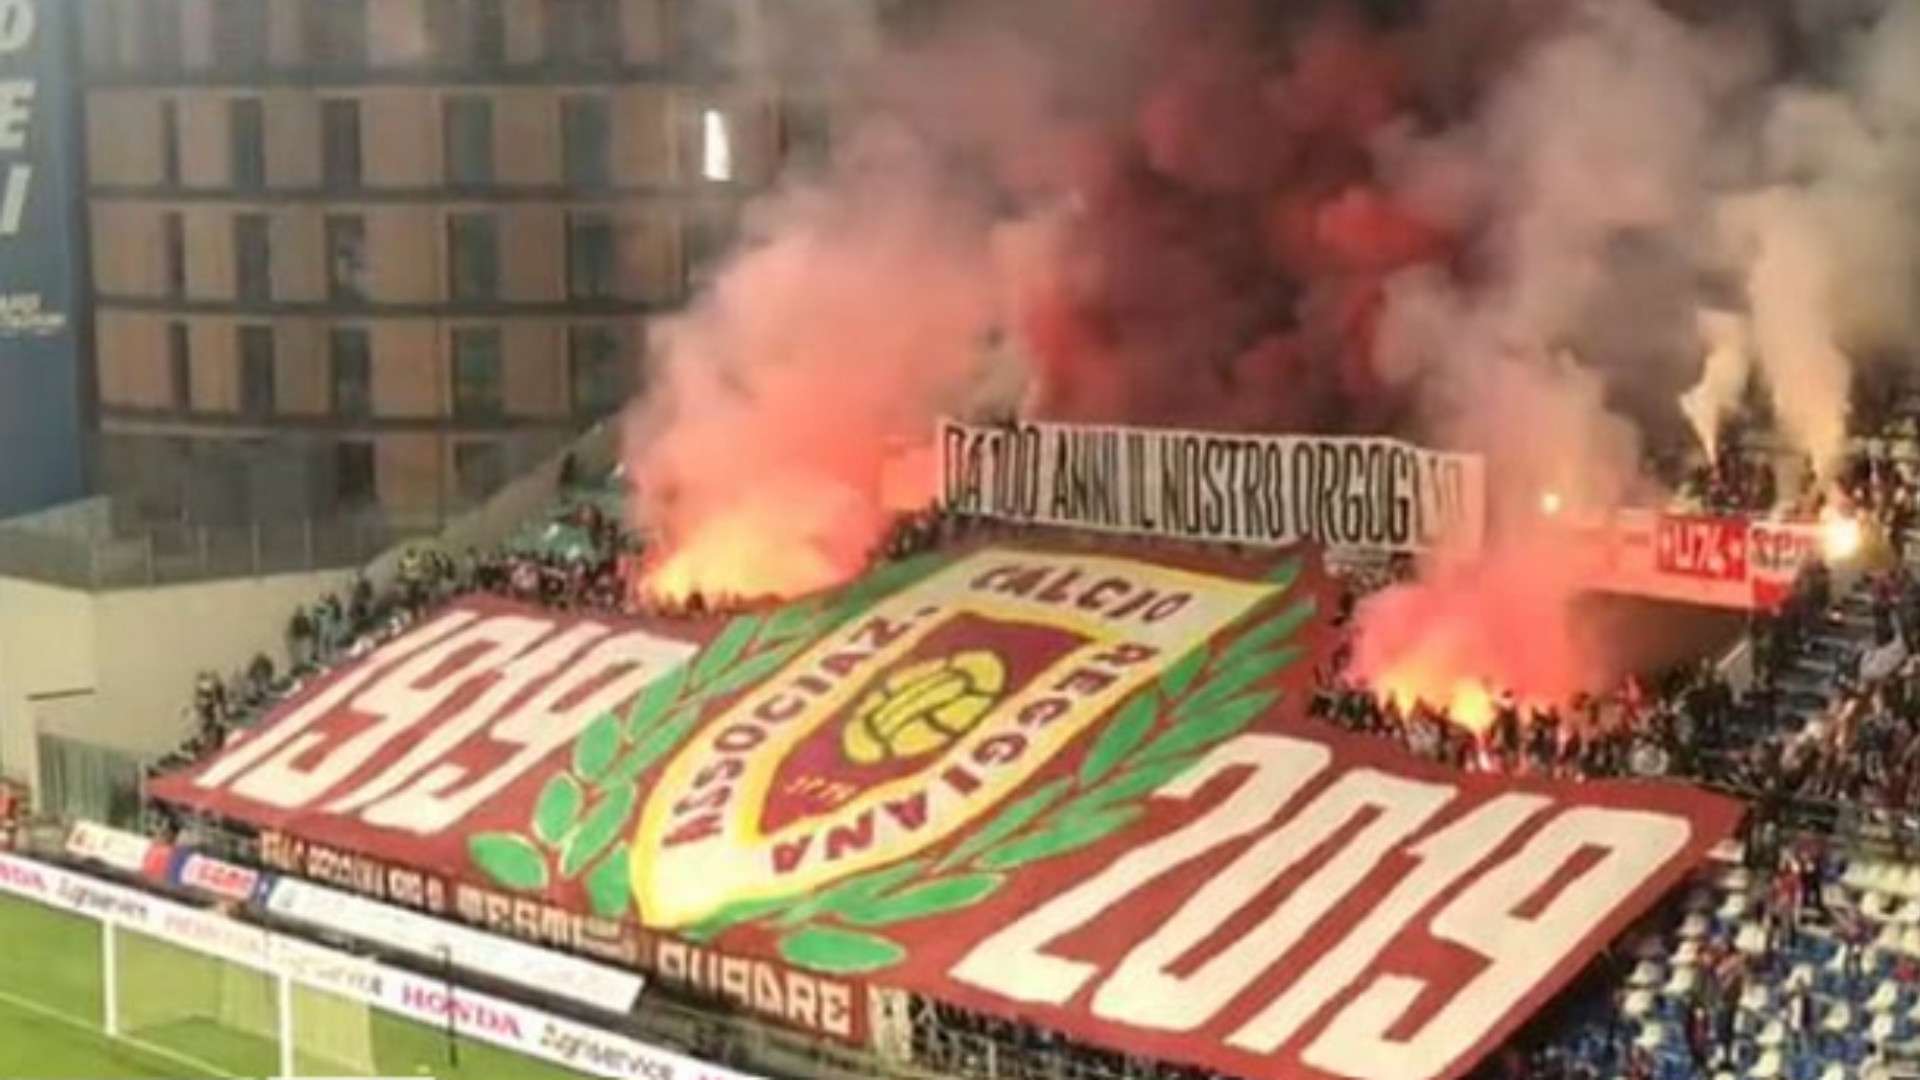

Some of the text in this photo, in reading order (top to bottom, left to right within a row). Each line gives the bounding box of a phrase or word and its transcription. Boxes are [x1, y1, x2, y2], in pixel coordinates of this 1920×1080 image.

[1052, 431, 1120, 528] ANNI
[1127, 433, 1155, 528] IL
[1160, 436, 1284, 540] NOSTRO
[970, 563, 1195, 623] CALCIO
[193, 610, 699, 835] 1919
[771, 641, 1162, 876] REGGIANA
[947, 733, 1692, 1080] 2019
[402, 984, 523, 1039] HONDA
